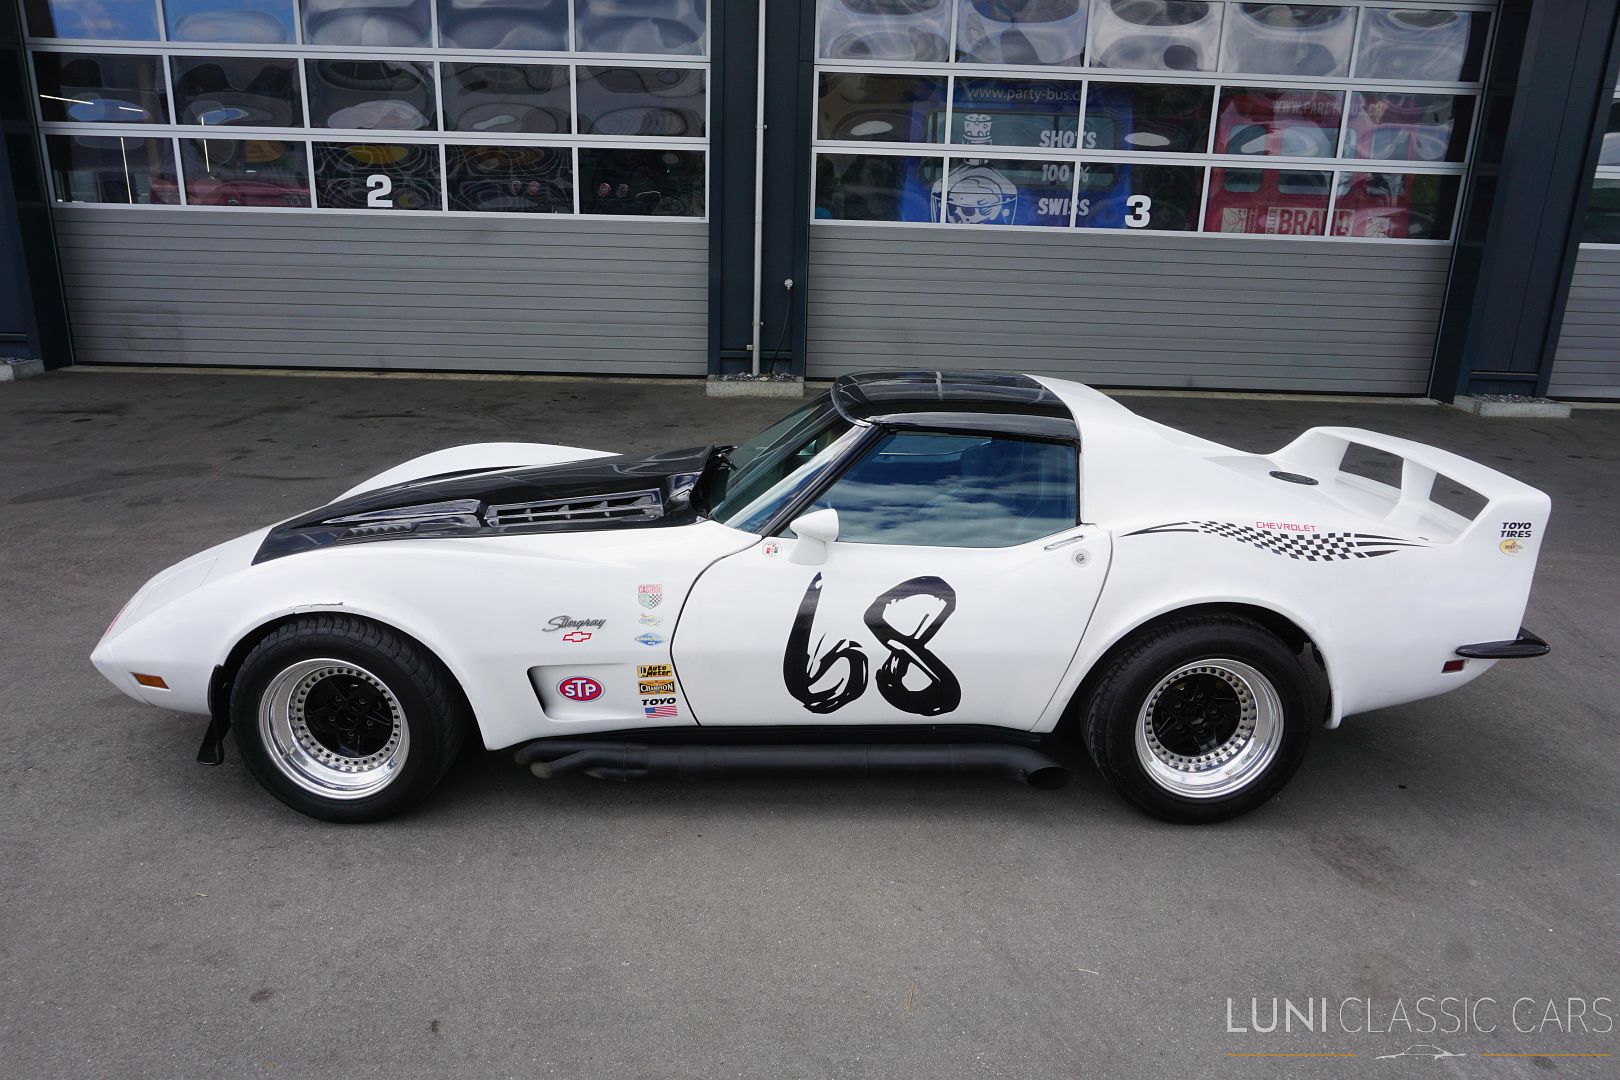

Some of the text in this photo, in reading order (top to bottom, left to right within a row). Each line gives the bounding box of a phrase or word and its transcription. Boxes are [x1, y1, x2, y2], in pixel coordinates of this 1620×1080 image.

[967, 88, 1082, 102] www.party-bus.c
[1042, 164, 1070, 182] 100
[366, 174, 393, 208] 2
[1124, 194, 1152, 228] 3
[1256, 521, 1316, 533] CHEVROLET
[1500, 530, 1532, 538] TIRES
[1502, 522, 1532, 530] TOYO
[542, 615, 607, 632] Stingray
[783, 571, 962, 717] 68
[564, 680, 597, 698] STP
[641, 697, 677, 706] TOYO
